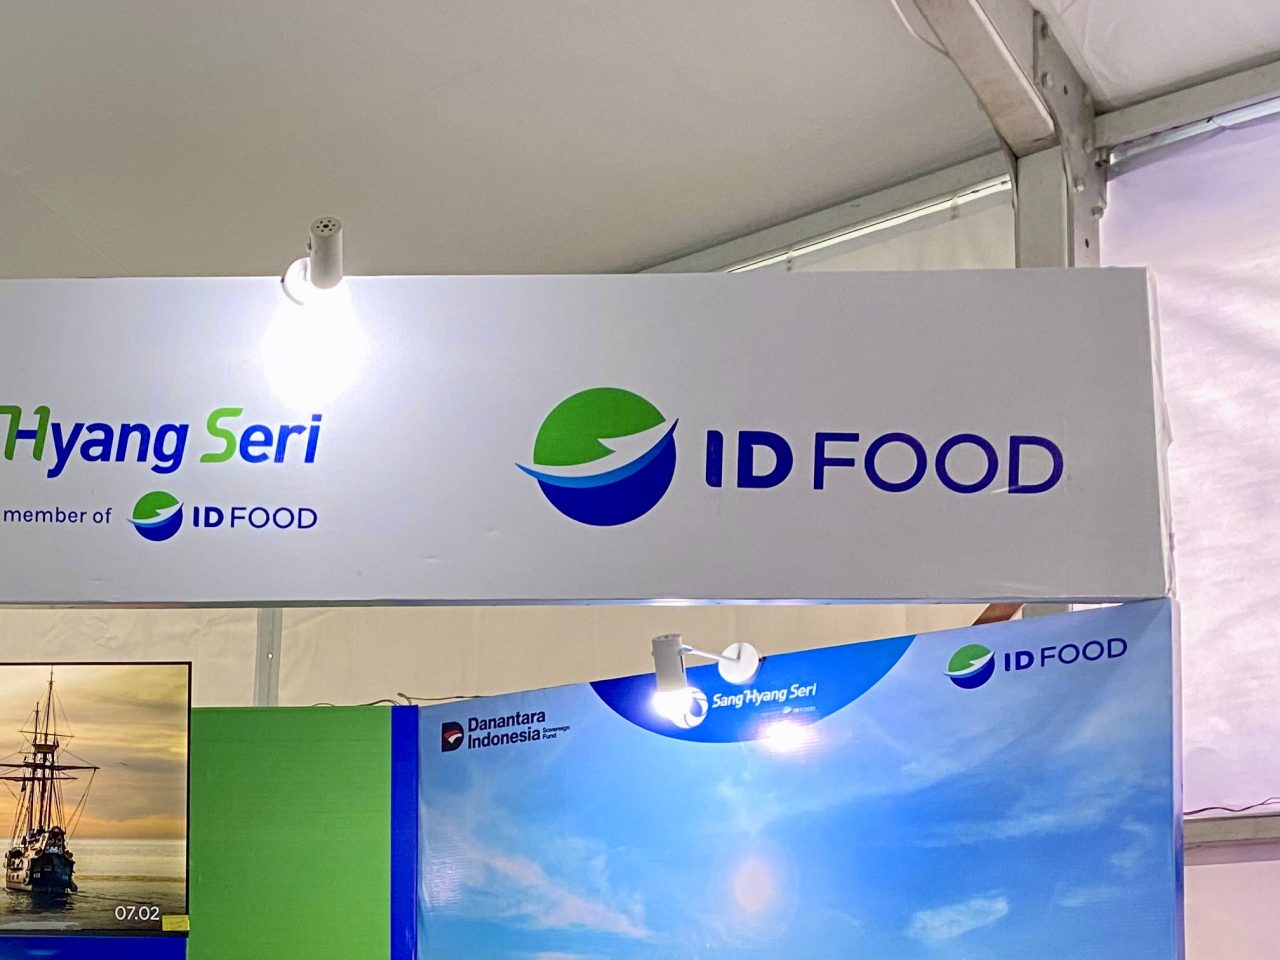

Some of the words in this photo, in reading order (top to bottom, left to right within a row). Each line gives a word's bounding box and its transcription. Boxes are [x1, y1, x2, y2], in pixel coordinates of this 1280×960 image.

[200, 407, 322, 463] Seri
[705, 430, 793, 488] ID
[813, 432, 1064, 494] FOOD
[3, 506, 87, 525] member
[92, 507, 112, 525] of
[193, 507, 224, 528] ID
[231, 507, 318, 529] FOOD
[1004, 650, 1034, 671] ID
[1040, 637, 1128, 667] FOOD
[712, 693, 743, 708] Sang
[743, 688, 787, 706] Hyang
[789, 683, 817, 699] Seri
[468, 711, 545, 732] Danantara
[468, 727, 540, 749] Indonesia
[543, 732, 557, 740] Fund
[114, 906, 160, 921] 07.02
